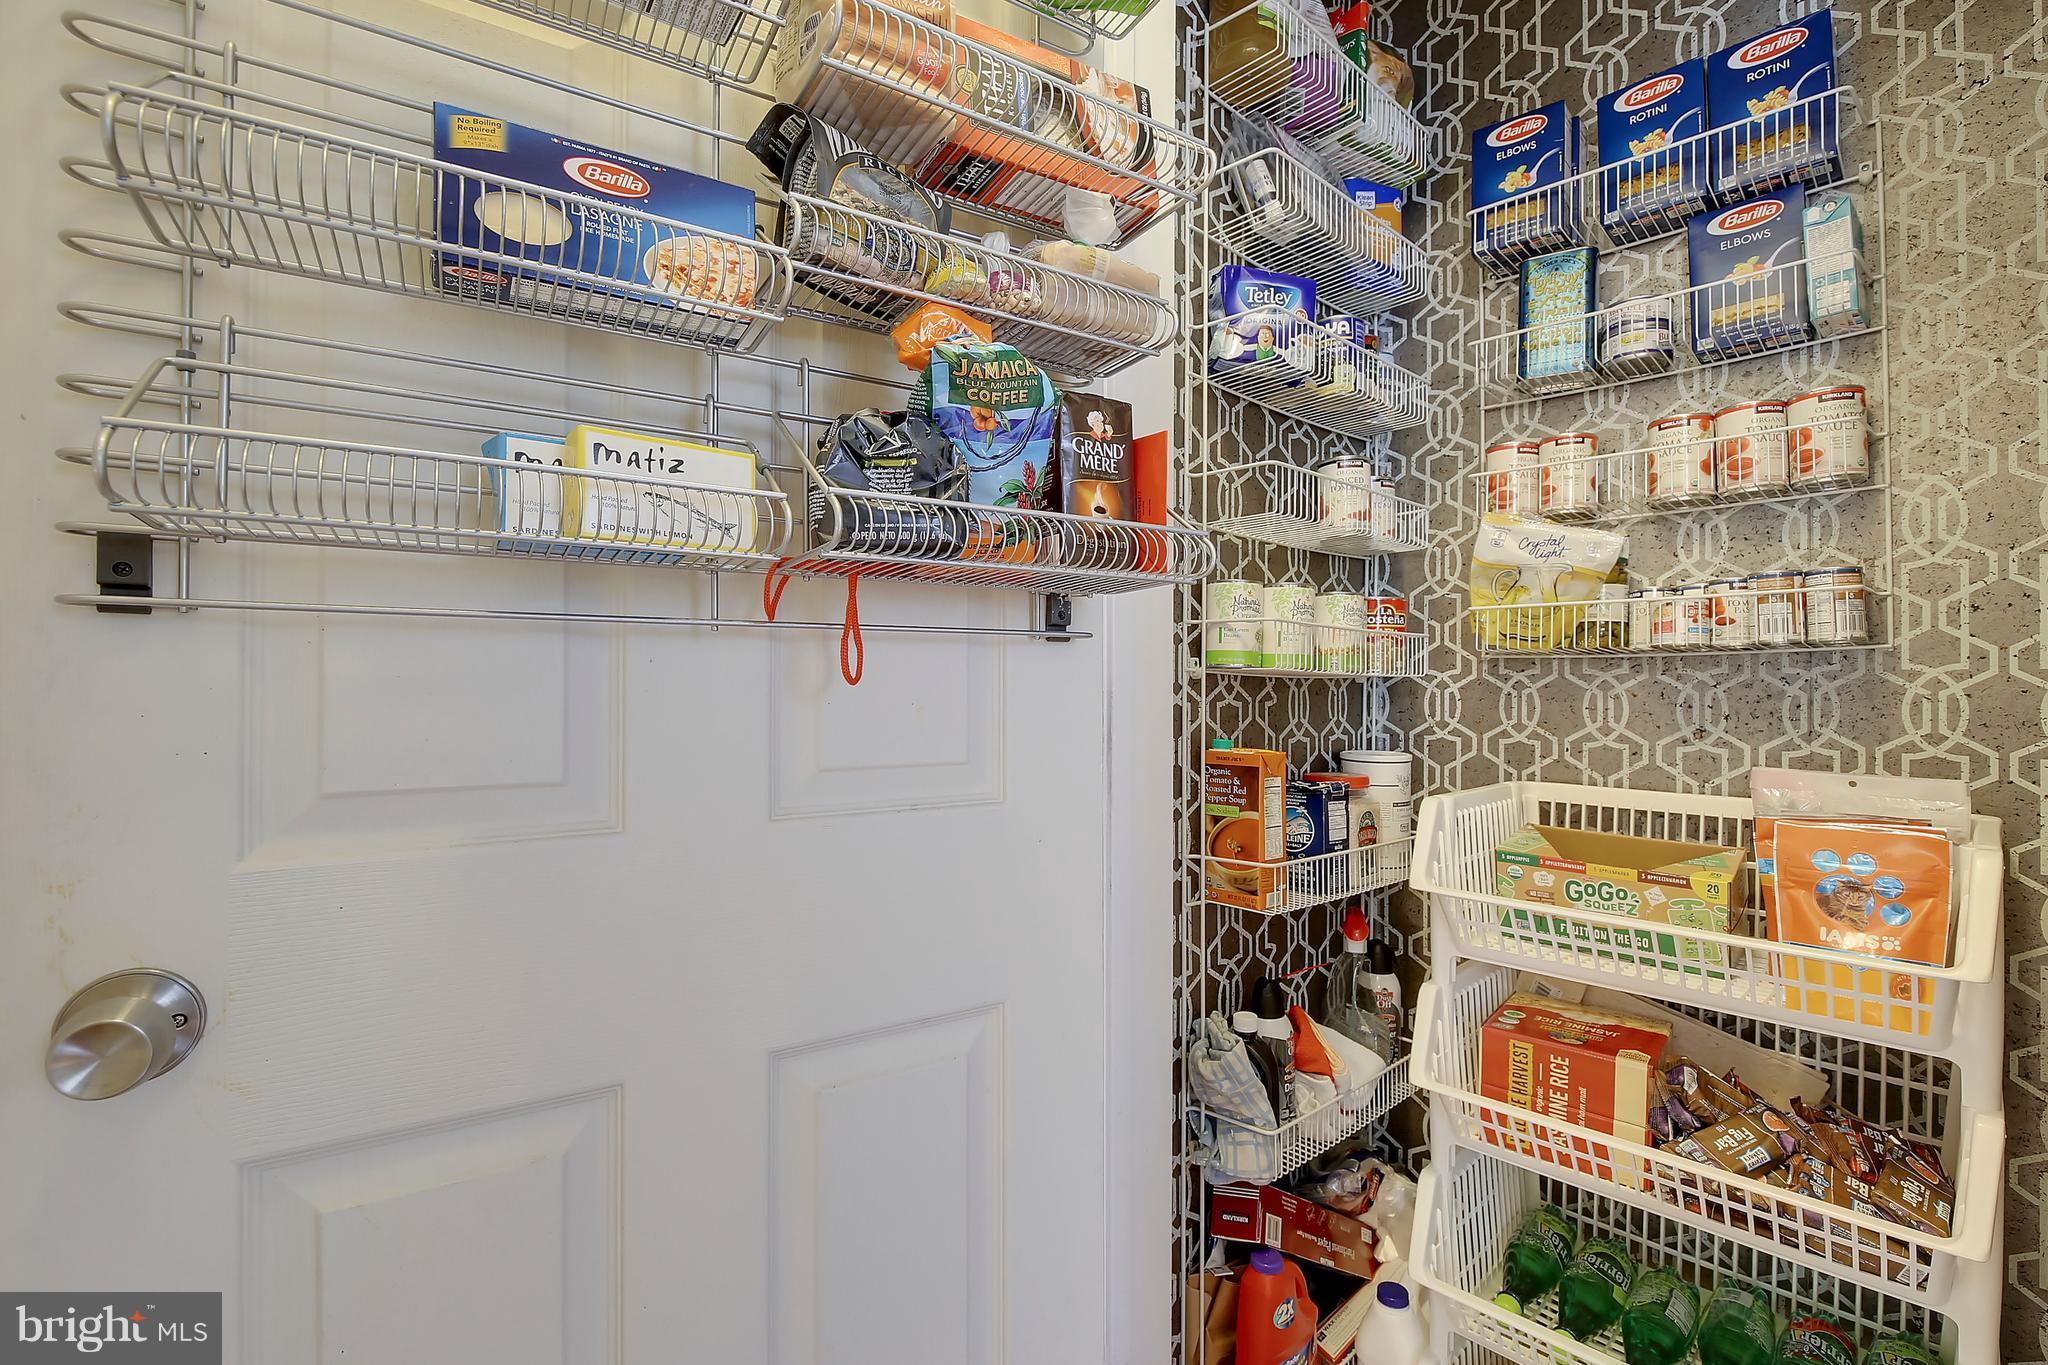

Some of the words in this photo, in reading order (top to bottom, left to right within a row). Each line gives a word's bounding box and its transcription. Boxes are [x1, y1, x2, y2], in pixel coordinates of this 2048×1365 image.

[1747, 32, 1801, 62] Barilla
[1746, 58, 1791, 83] ROTINI
[1630, 77, 1678, 105] Barilla
[1629, 103, 1667, 125] ROTINI
[457, 124, 496, 134] Required
[473, 118, 502, 129] Boiling
[1500, 118, 1542, 140] Barilla
[1496, 141, 1537, 161] ELBOWS
[584, 165, 644, 193] Barilla
[1724, 203, 1778, 230] Barilla
[1720, 229, 1771, 252] ELBOWS
[1245, 286, 1293, 309] Tetley
[953, 357, 1037, 380] JAMAICA
[956, 378, 987, 389] BLUE
[990, 380, 1038, 390] MOUNTAIN
[966, 388, 1029, 405] COFFEE
[1822, 392, 1854, 400] KIRKLAND
[1814, 403, 1858, 413] ORGANIC
[1661, 418, 1688, 429] KIRKLAND
[1817, 421, 1858, 433] SAUCE
[1754, 432, 1787, 442] SAUC
[1518, 534, 1566, 552] Crystal
[1381, 607, 1392, 615] La
[1205, 766, 1232, 775] Organic
[1205, 775, 1232, 785] Tomato
[1233, 777, 1241, 785] &
[1233, 786, 1247, 795] Red
[1228, 794, 1247, 806] Soup
[1286, 834, 1311, 842] LEINE
[1565, 880, 1628, 903] GoGo
[1707, 884, 1720, 895] 20
[1560, 923, 1589, 938] FUIT
[1594, 929, 1608, 941] ON
[1819, 926, 1881, 950] IAMS
[1377, 1000, 1392, 1008] Off
[1534, 1015, 1562, 1027] RICE
[1566, 1021, 1621, 1037] JASMINE
[1511, 1042, 1529, 1096] HARVEST
[1550, 1054, 1569, 1090] RICE
[1535, 1085, 1544, 1112] organic
[1714, 1136, 1741, 1151] Bar
[1728, 1126, 1756, 1145] Fig
[1844, 1176, 1869, 1197] Bar
